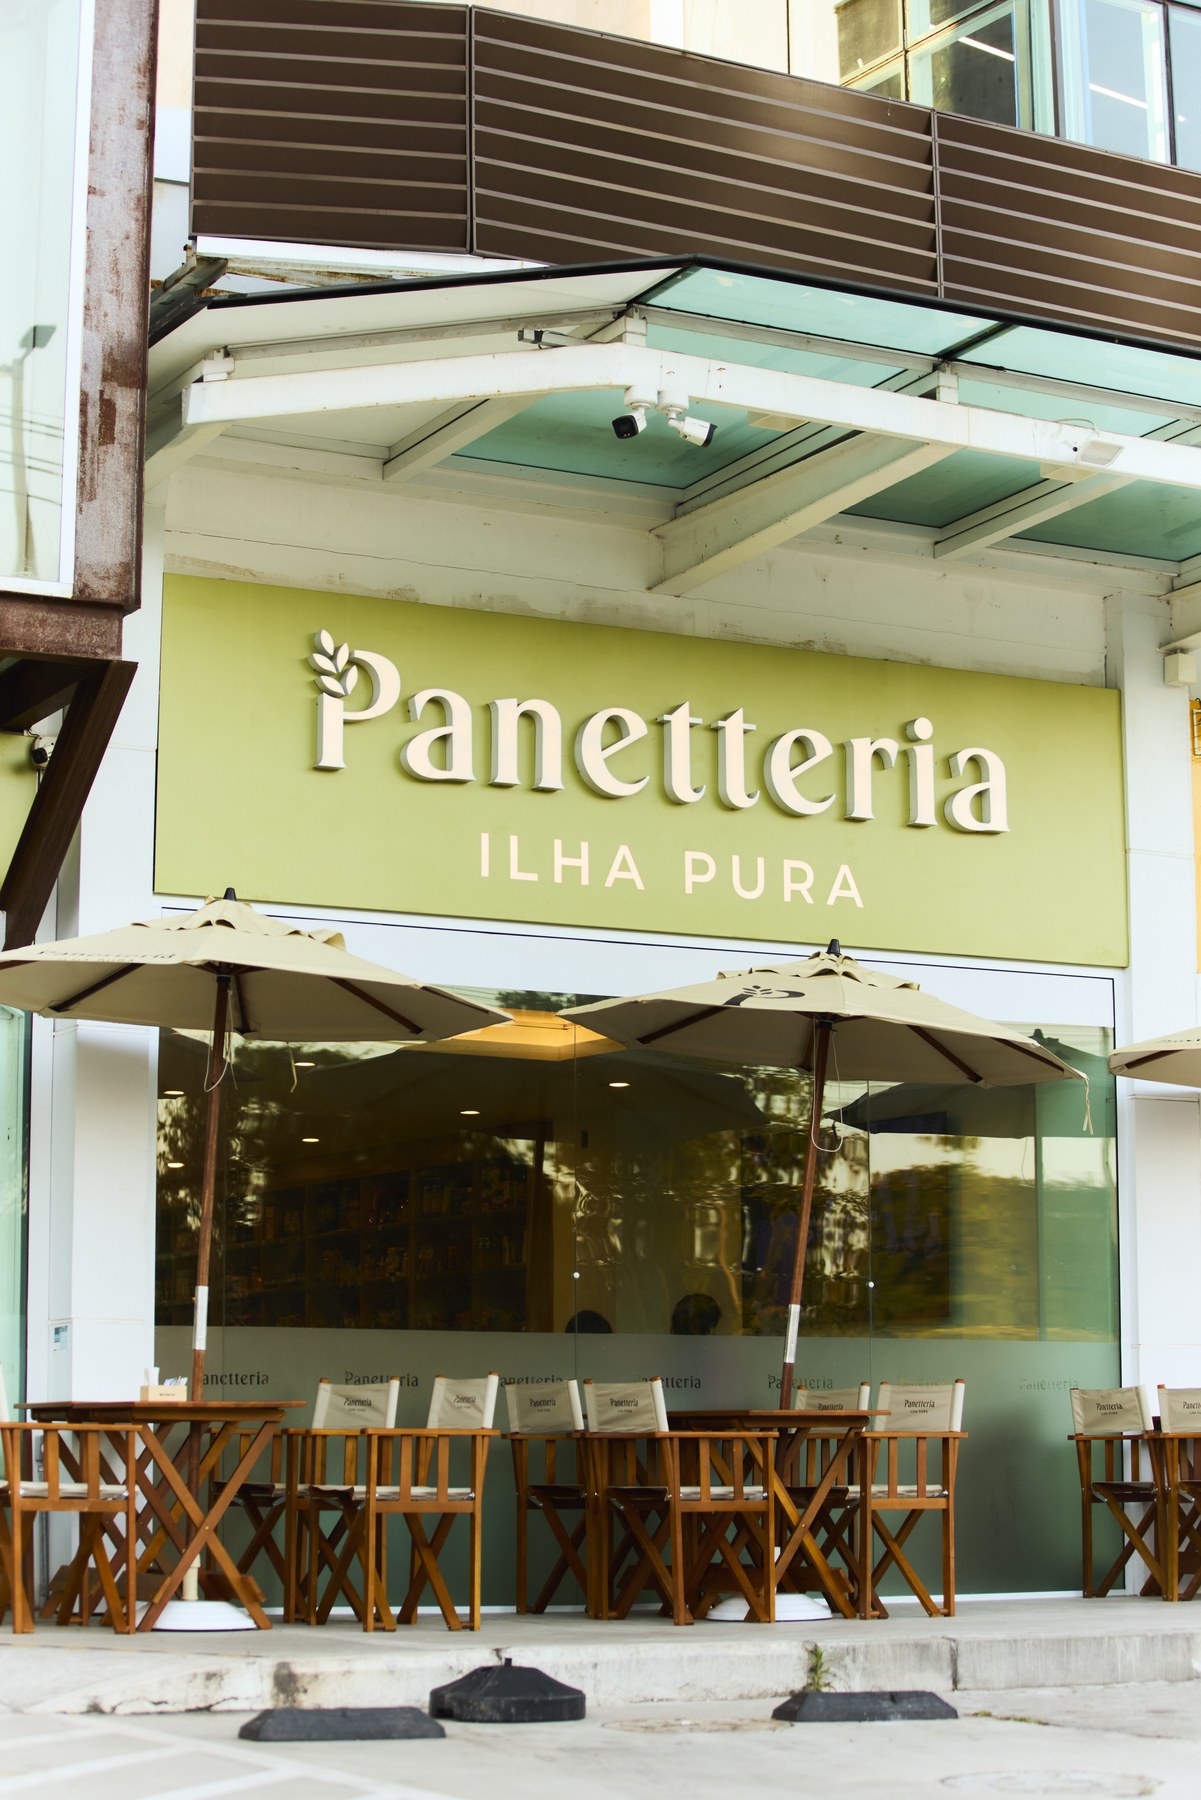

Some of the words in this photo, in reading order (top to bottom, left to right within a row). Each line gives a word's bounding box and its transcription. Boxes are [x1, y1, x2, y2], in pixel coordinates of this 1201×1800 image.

[307, 629, 1010, 834] Panetteria
[480, 832, 645, 891] ILHA
[684, 850, 864, 909] PURA
[202, 1371, 269, 1386] anetteria
[345, 1371, 419, 1387] Panetria
[500, 1374, 563, 1387] anetteri
[768, 1374, 833, 1389] Paetteria
